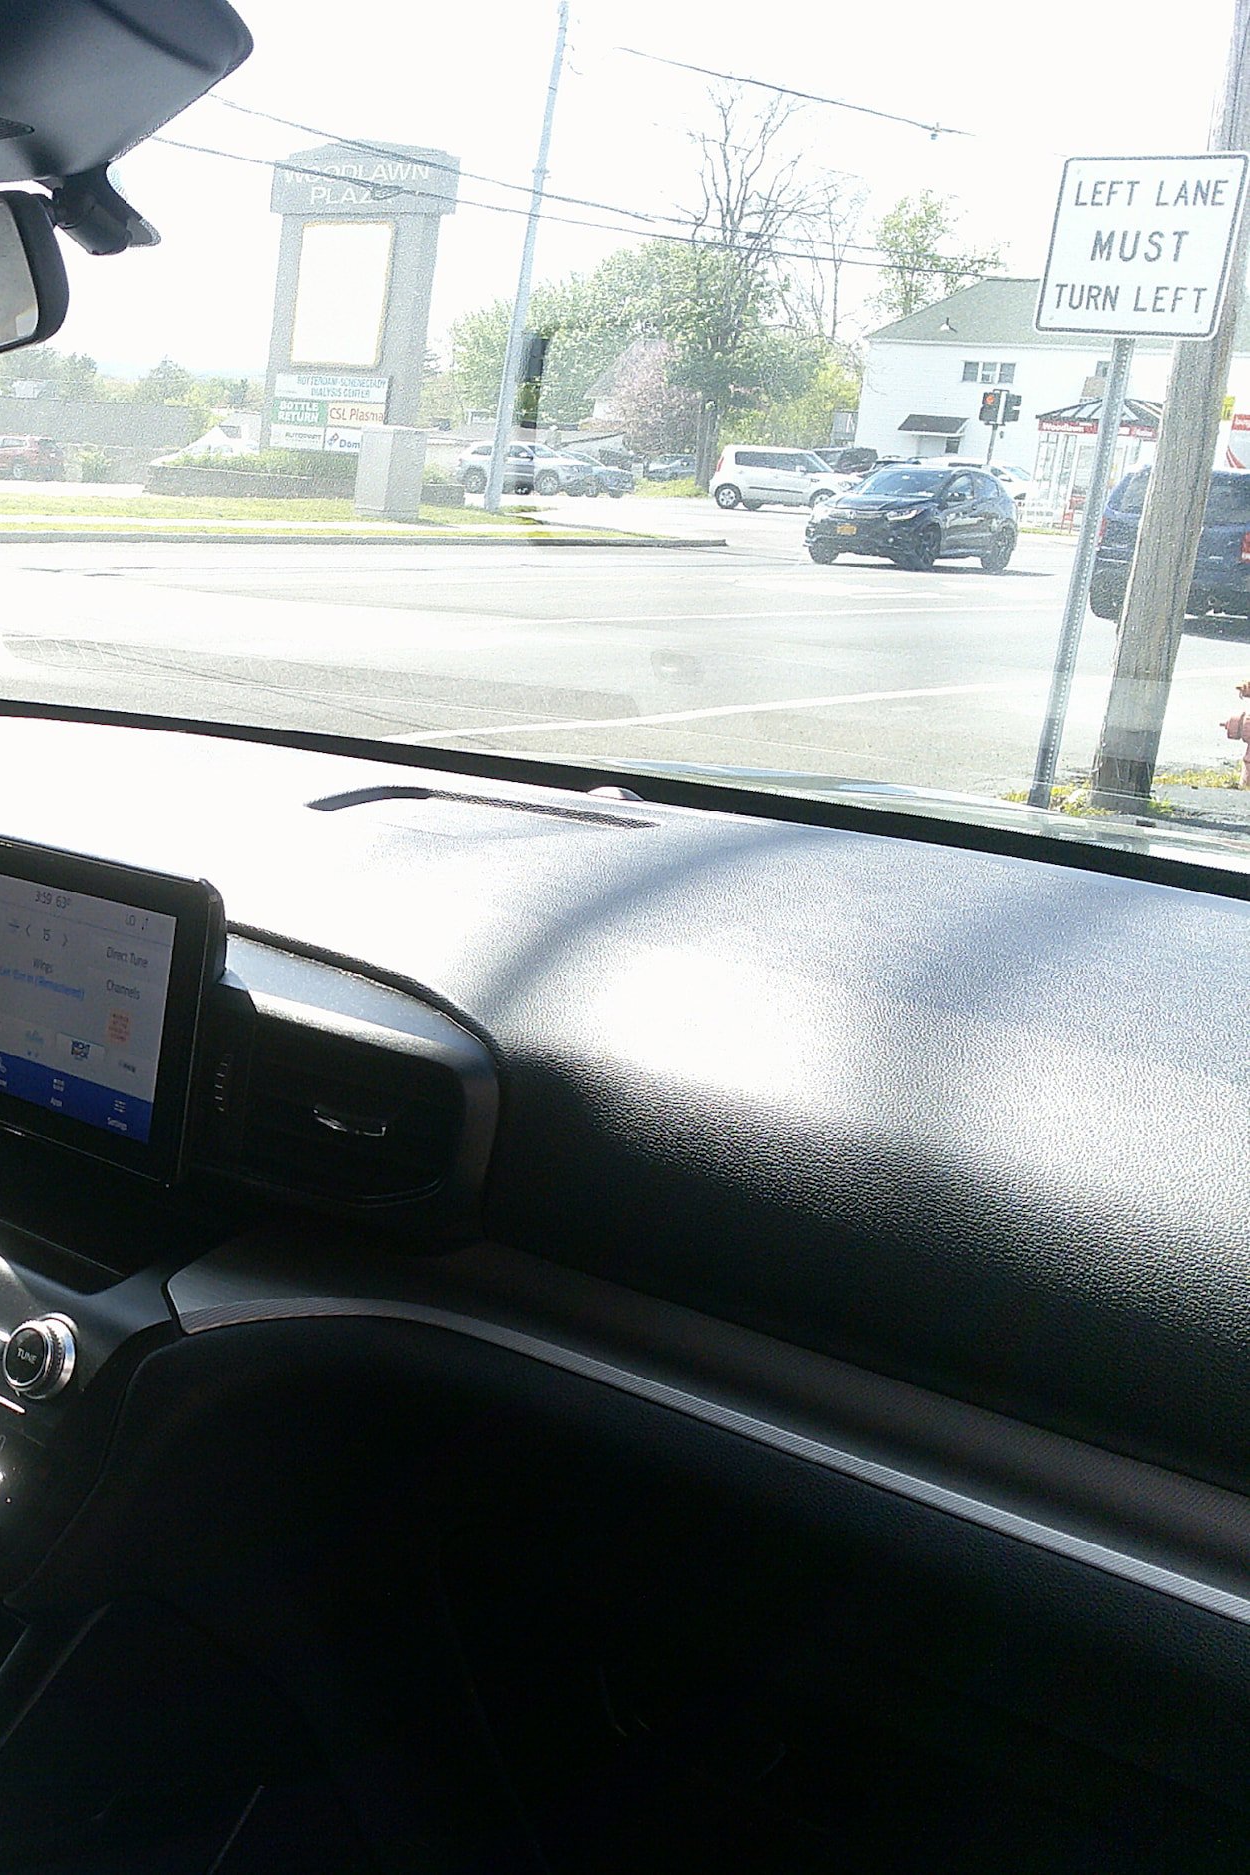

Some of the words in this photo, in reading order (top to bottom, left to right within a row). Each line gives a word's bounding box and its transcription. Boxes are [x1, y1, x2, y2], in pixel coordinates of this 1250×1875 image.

[284, 163, 430, 184] WOODLAWN
[309, 186, 393, 205] PLAZ
[1074, 179, 1141, 206] LEFT
[1155, 179, 1229, 206] LANE
[1090, 230, 1190, 262] MUST
[1055, 283, 1120, 312] TURN
[1133, 286, 1208, 314] LEFT
[279, 400, 320, 412] BOTTLE
[329, 407, 348, 421] CSL
[349, 407, 386, 422] Plasma
[277, 410, 320, 423] RETURN
[338, 438, 361, 449] Dom
[35, 890, 52, 905] 3:59
[106, 946, 128, 963] Direct
[130, 952, 149, 969] Tune
[106, 979, 141, 1001] Channels
[17, 1347, 38, 1365] TUNE
